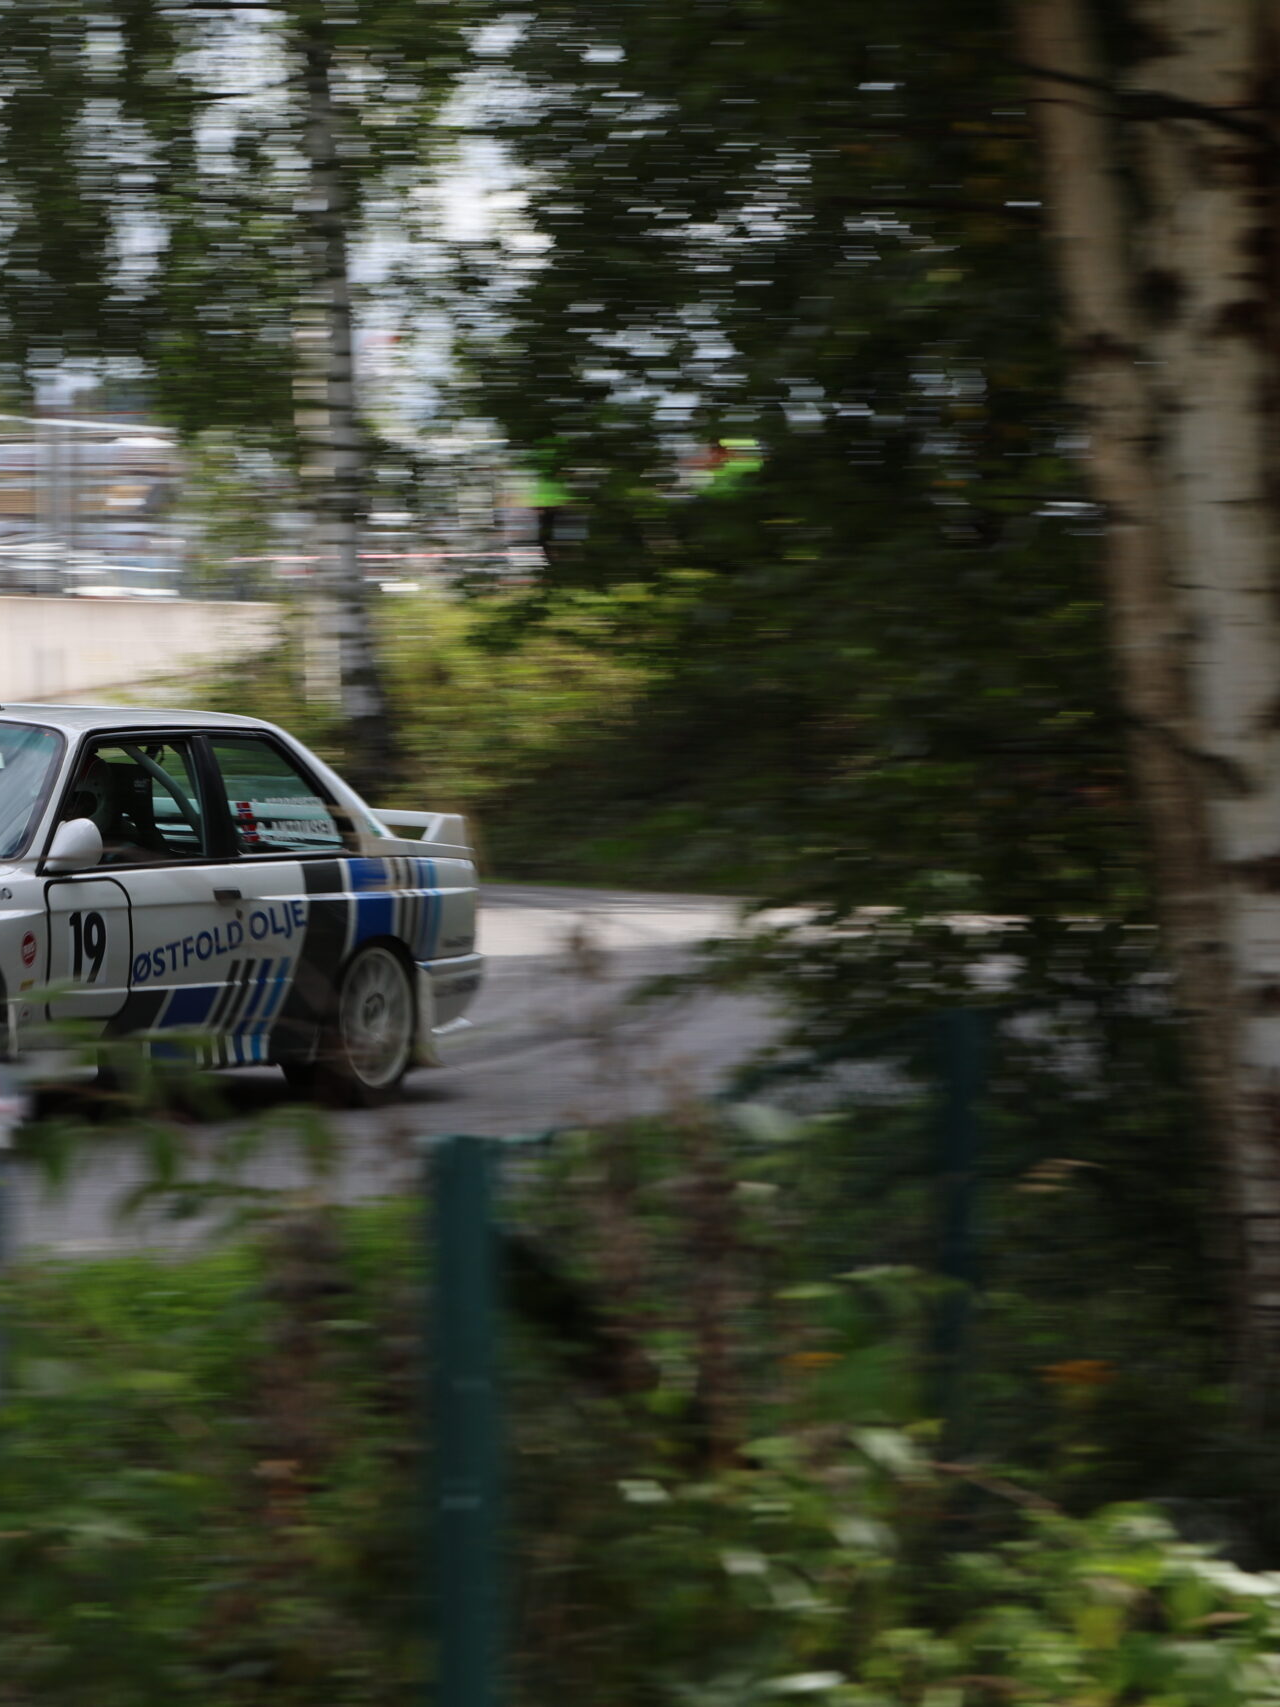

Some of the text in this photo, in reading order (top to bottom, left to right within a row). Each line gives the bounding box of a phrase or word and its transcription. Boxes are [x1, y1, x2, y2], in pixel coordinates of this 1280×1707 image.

[69, 911, 107, 984] 19
[133, 899, 308, 985] ØSTFOLD OLJE
